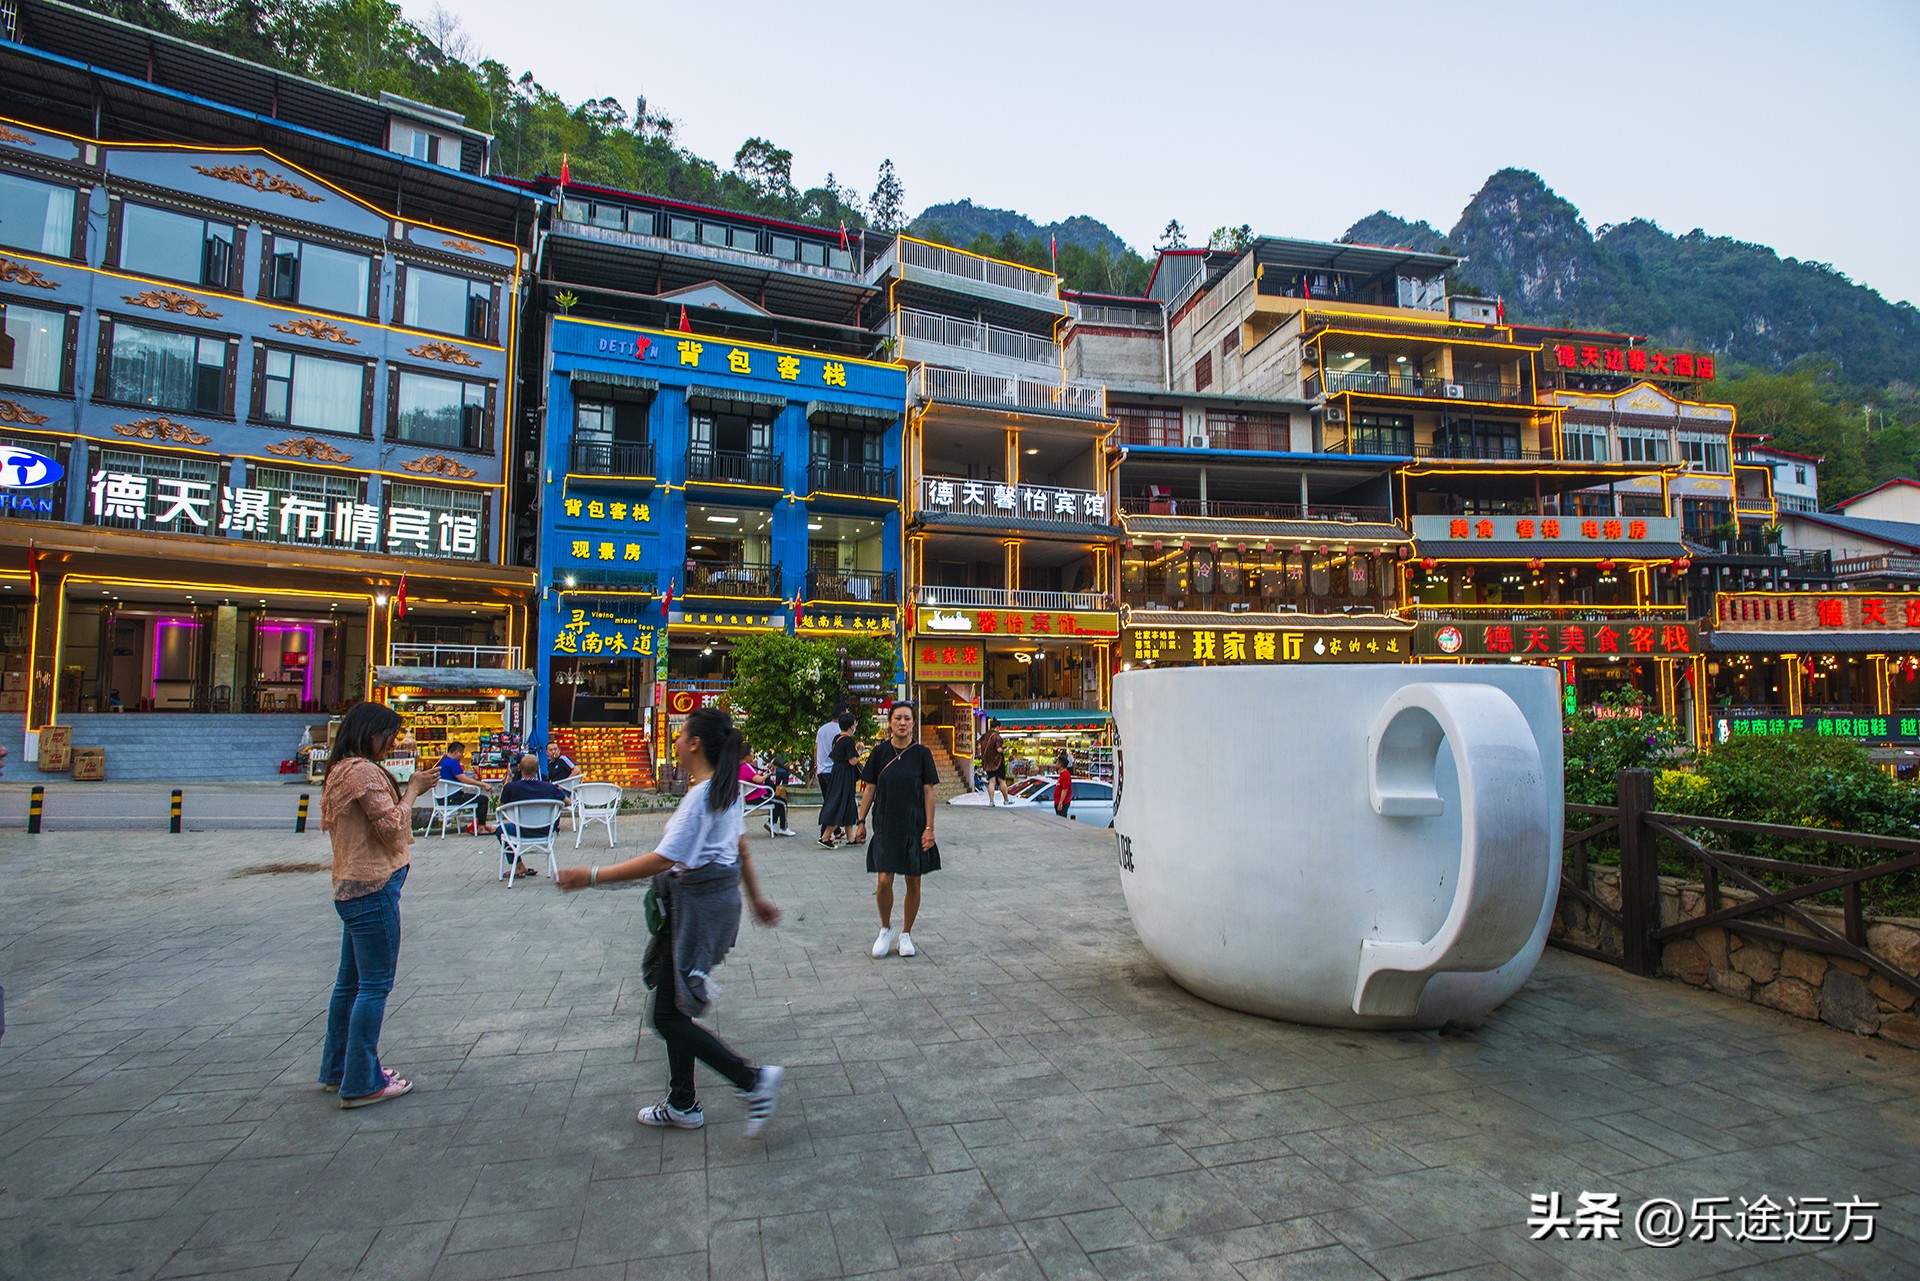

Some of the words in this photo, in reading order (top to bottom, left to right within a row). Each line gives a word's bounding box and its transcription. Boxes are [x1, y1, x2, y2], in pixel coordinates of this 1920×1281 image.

[677, 341, 846, 387] 背包客栈
[1555, 344, 1714, 379] 德天边寨大酒店
[928, 480, 1105, 517] 德天馨怡宾馆
[91, 470, 476, 553] 德天瀑布情宾馆
[564, 499, 650, 522] 背包客栈
[1450, 519, 1494, 538] 美食
[1517, 519, 1560, 539] 客栈
[1582, 520, 1647, 539] 电梯房
[572, 541, 640, 561] 观景房
[565, 609, 591, 635] 寻
[684, 613, 768, 626] 越南特色餐厅
[802, 615, 844, 628] 越南菜
[852, 616, 892, 631] 本地菜
[977, 611, 1078, 634] 馨怡宾馆
[553, 630, 653, 655] 越南味道
[1193, 631, 1304, 660] 我家餐厅
[1329, 637, 1399, 656] 家的味道
[1484, 625, 1690, 653] 德天美食客栈
[921, 645, 978, 664] 农家菜
[1733, 718, 1804, 736] 越南特产
[1817, 718, 1887, 737] 橡胶拖鞋
